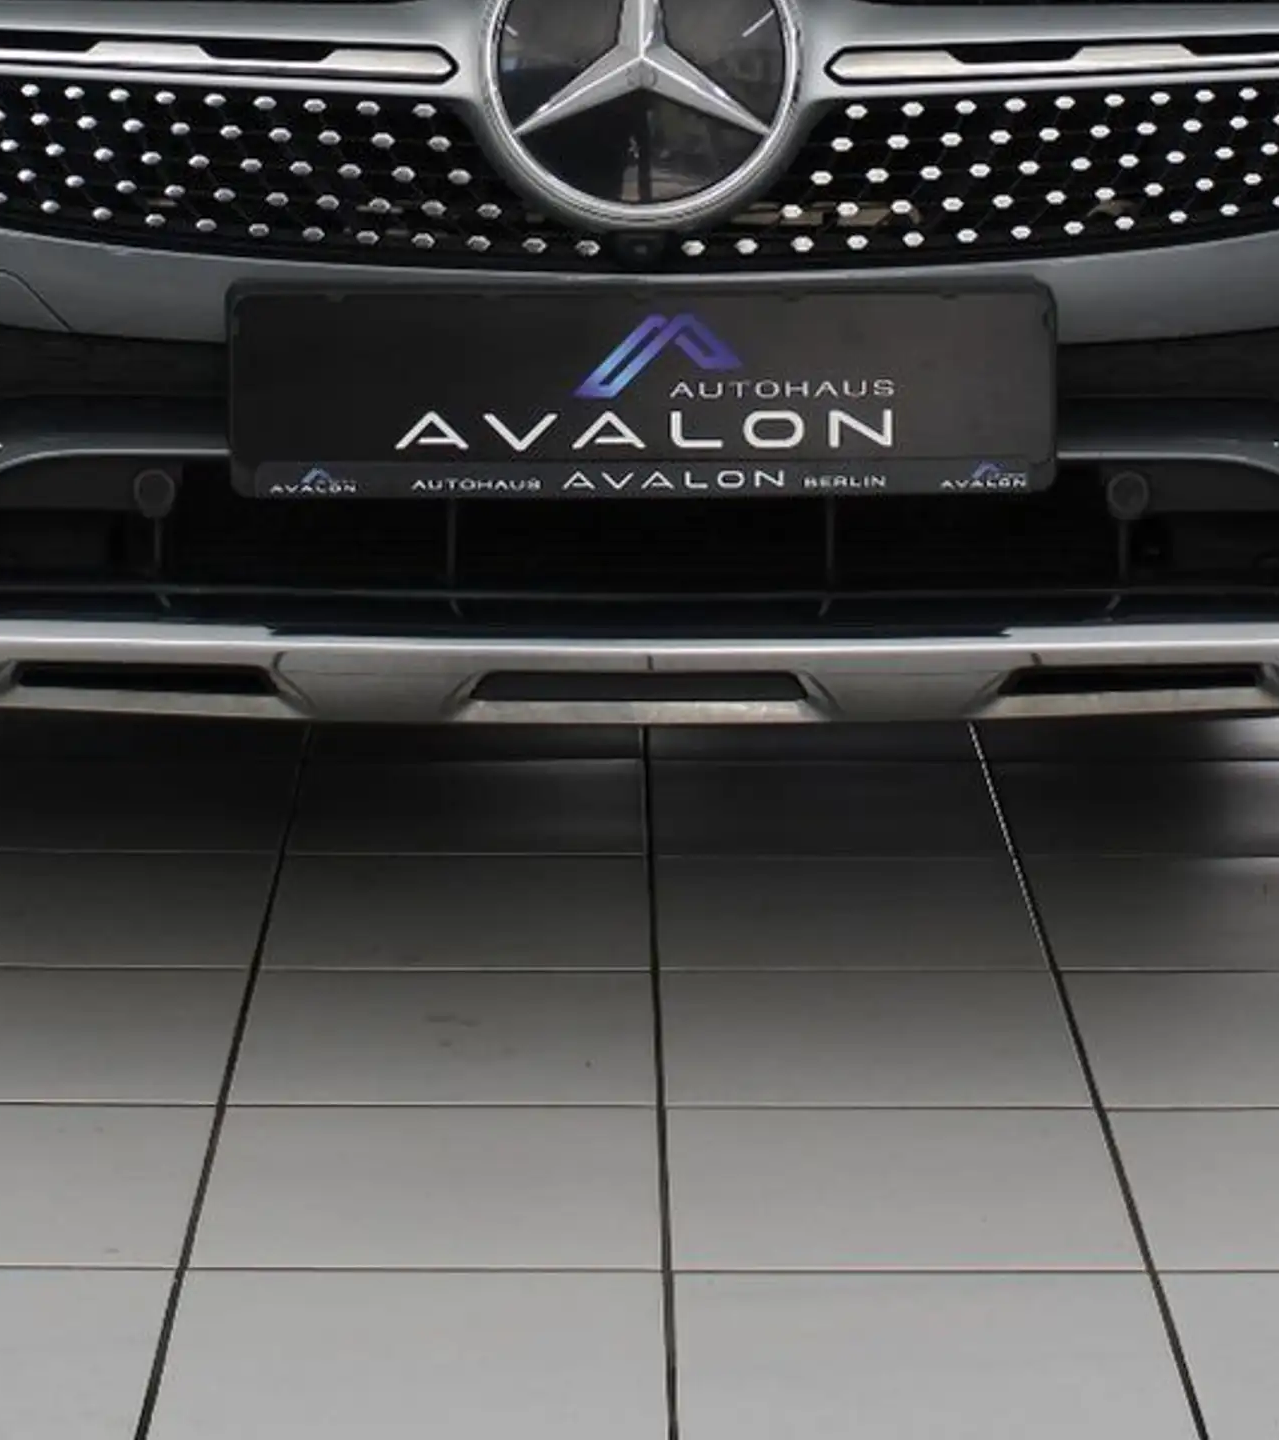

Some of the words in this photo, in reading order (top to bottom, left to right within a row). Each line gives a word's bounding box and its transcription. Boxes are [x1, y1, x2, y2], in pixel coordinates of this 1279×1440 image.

[669, 379, 895, 398] AUTOHAUS
[395, 409, 893, 452] AVALON
[411, 478, 541, 491] AUTOHAUS
[562, 469, 785, 490] AVALON
[804, 475, 886, 488] BERLIN
